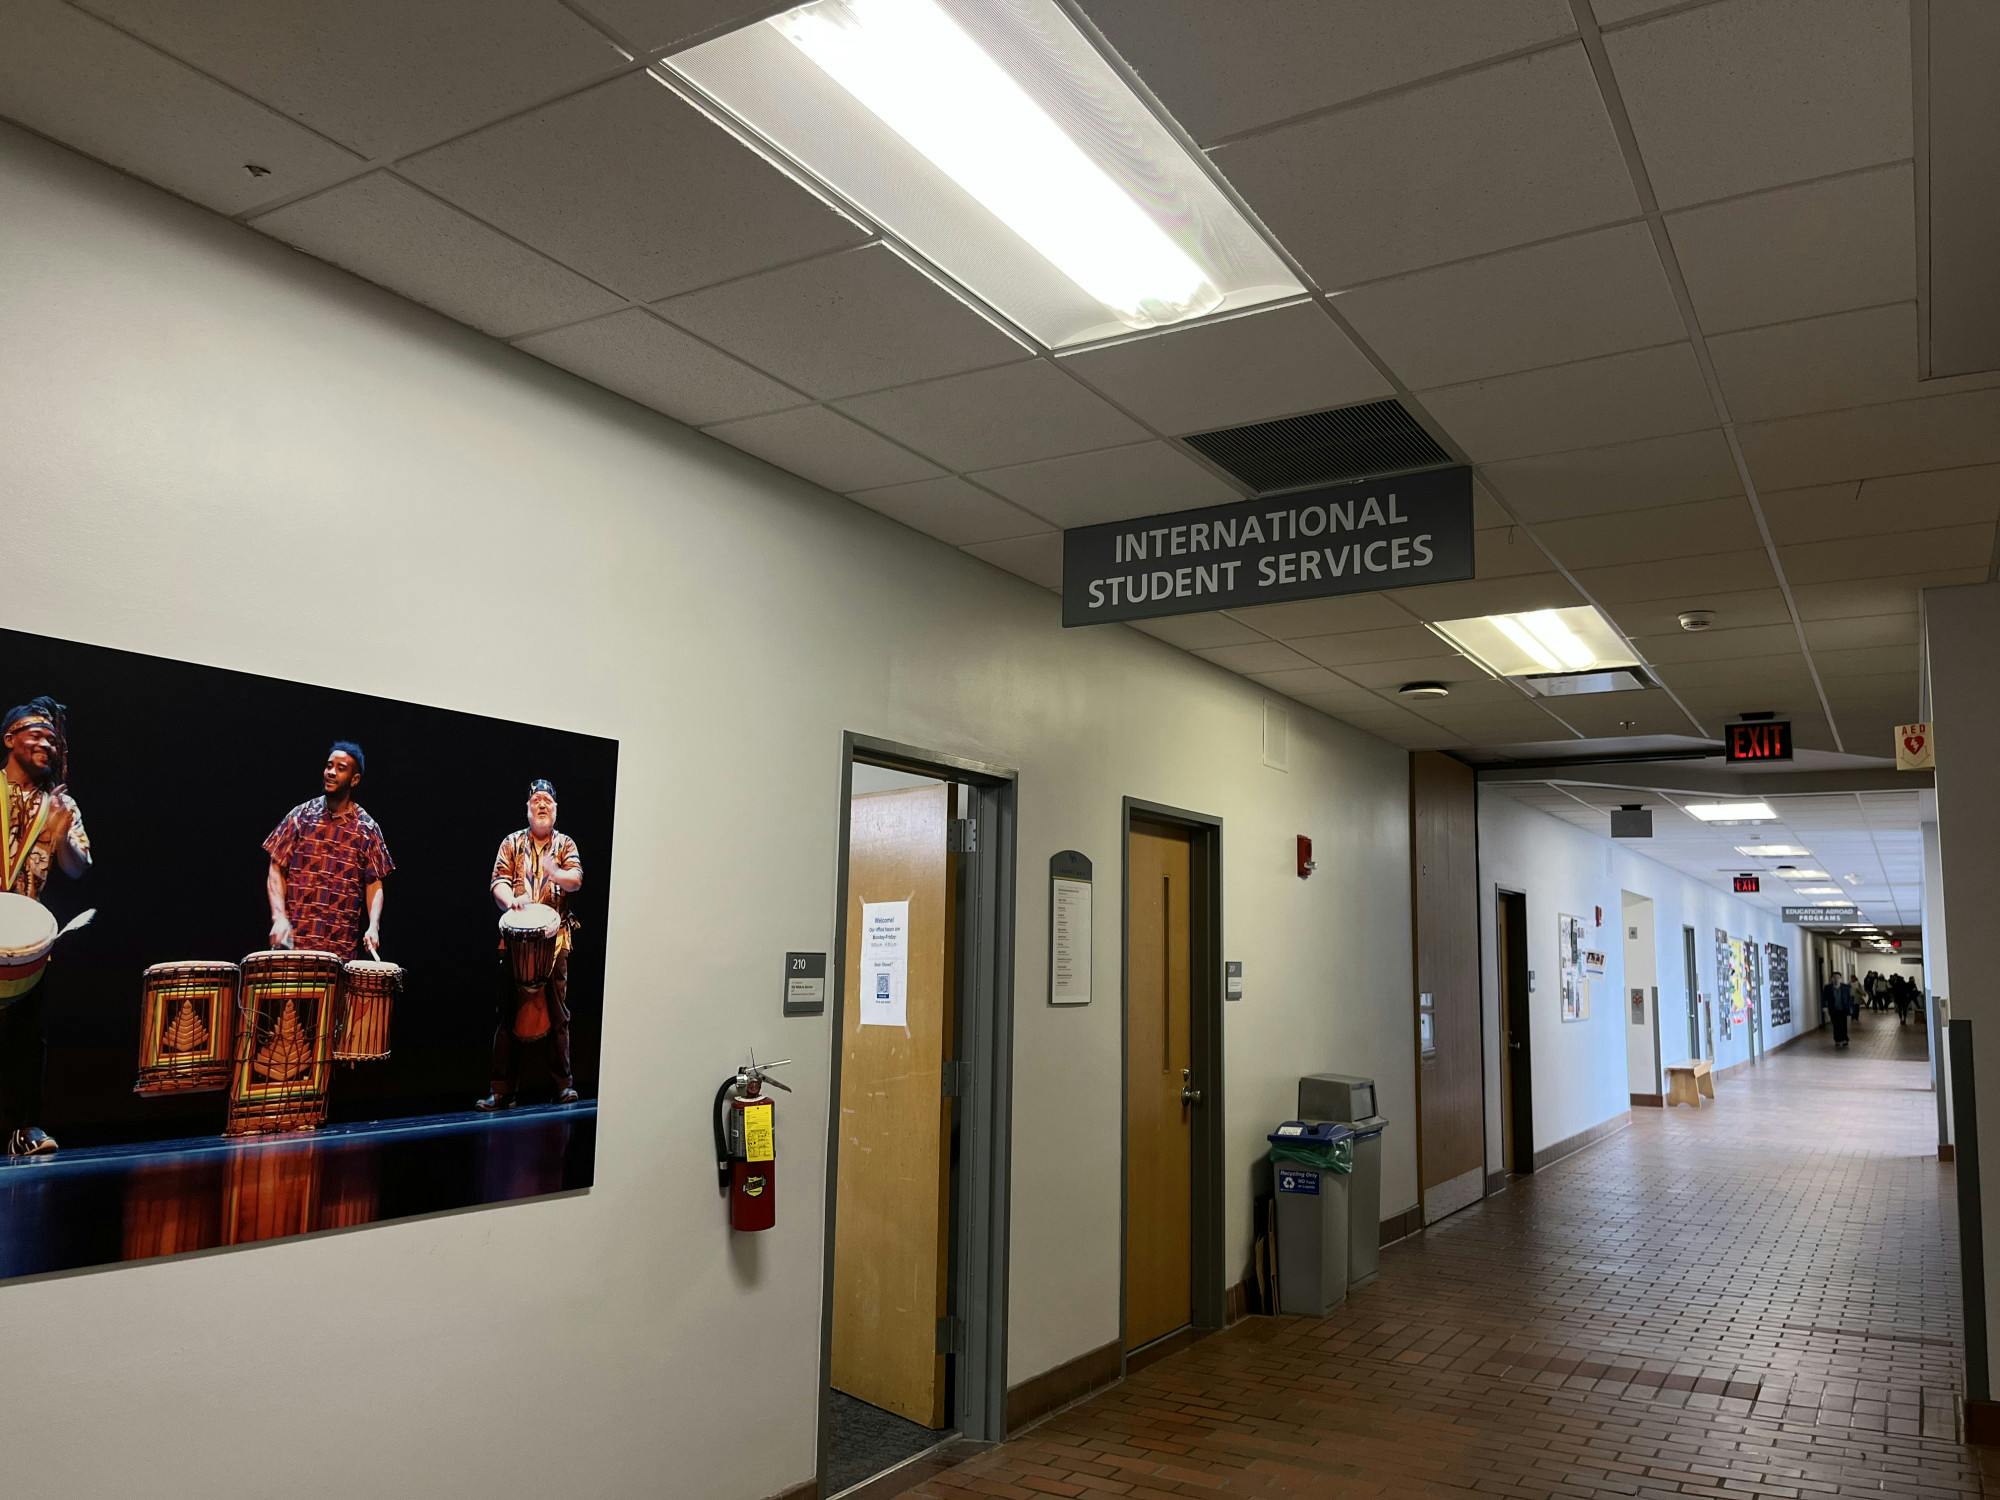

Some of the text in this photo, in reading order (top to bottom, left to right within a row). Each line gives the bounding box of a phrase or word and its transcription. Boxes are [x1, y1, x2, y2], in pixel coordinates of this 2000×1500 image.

[1114, 493, 1408, 563] INTERNATIONAL
[1088, 534, 1434, 609] STUDENT SERVICES
[1902, 724, 1926, 736] AED
[1733, 725, 1784, 758] EXIT
[1736, 880, 1757, 891] EXIT
[793, 959, 806, 969] 210
[1280, 1170, 1305, 1178] Recycling
